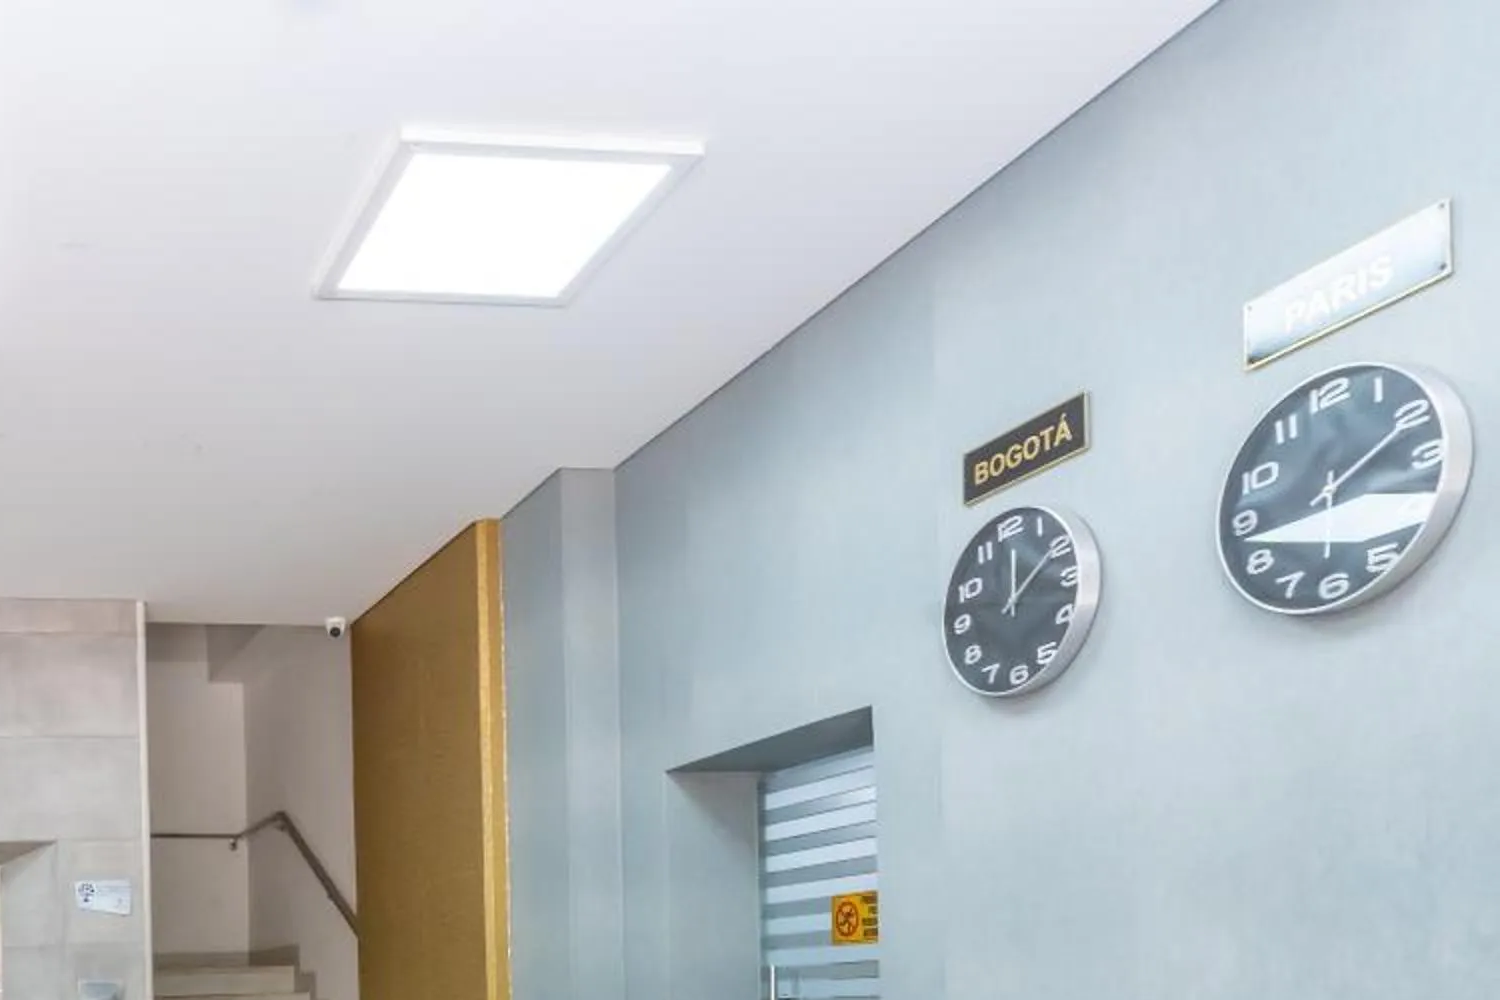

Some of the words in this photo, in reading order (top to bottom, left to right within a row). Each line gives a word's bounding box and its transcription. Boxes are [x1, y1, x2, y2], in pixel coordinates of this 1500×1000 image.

[1285, 253, 1394, 334] PARIS
[1308, 376, 1351, 414] 12
[1372, 376, 1384, 403] 1
[1393, 398, 1431, 433] 2
[1273, 414, 1299, 445] 11
[973, 412, 1073, 486] BOGOTÁ
[1411, 438, 1444, 470] 3
[1241, 460, 1280, 495] 10
[997, 515, 1025, 543] 12
[1036, 516, 1044, 538] 1
[1231, 509, 1258, 538] 9
[976, 541, 994, 565] 11
[1049, 535, 1072, 558] 2
[1366, 543, 1399, 574] 5
[1246, 548, 1275, 575] 8
[958, 577, 984, 603] 10
[1060, 566, 1079, 587] 3
[1276, 571, 1306, 599] 7
[1318, 572, 1349, 600] 6
[953, 613, 971, 635] 9
[1055, 603, 1076, 625] 4
[964, 644, 983, 665] 8
[1036, 641, 1058, 666] 5
[981, 663, 1001, 685] 7
[1009, 665, 1030, 686] 6
